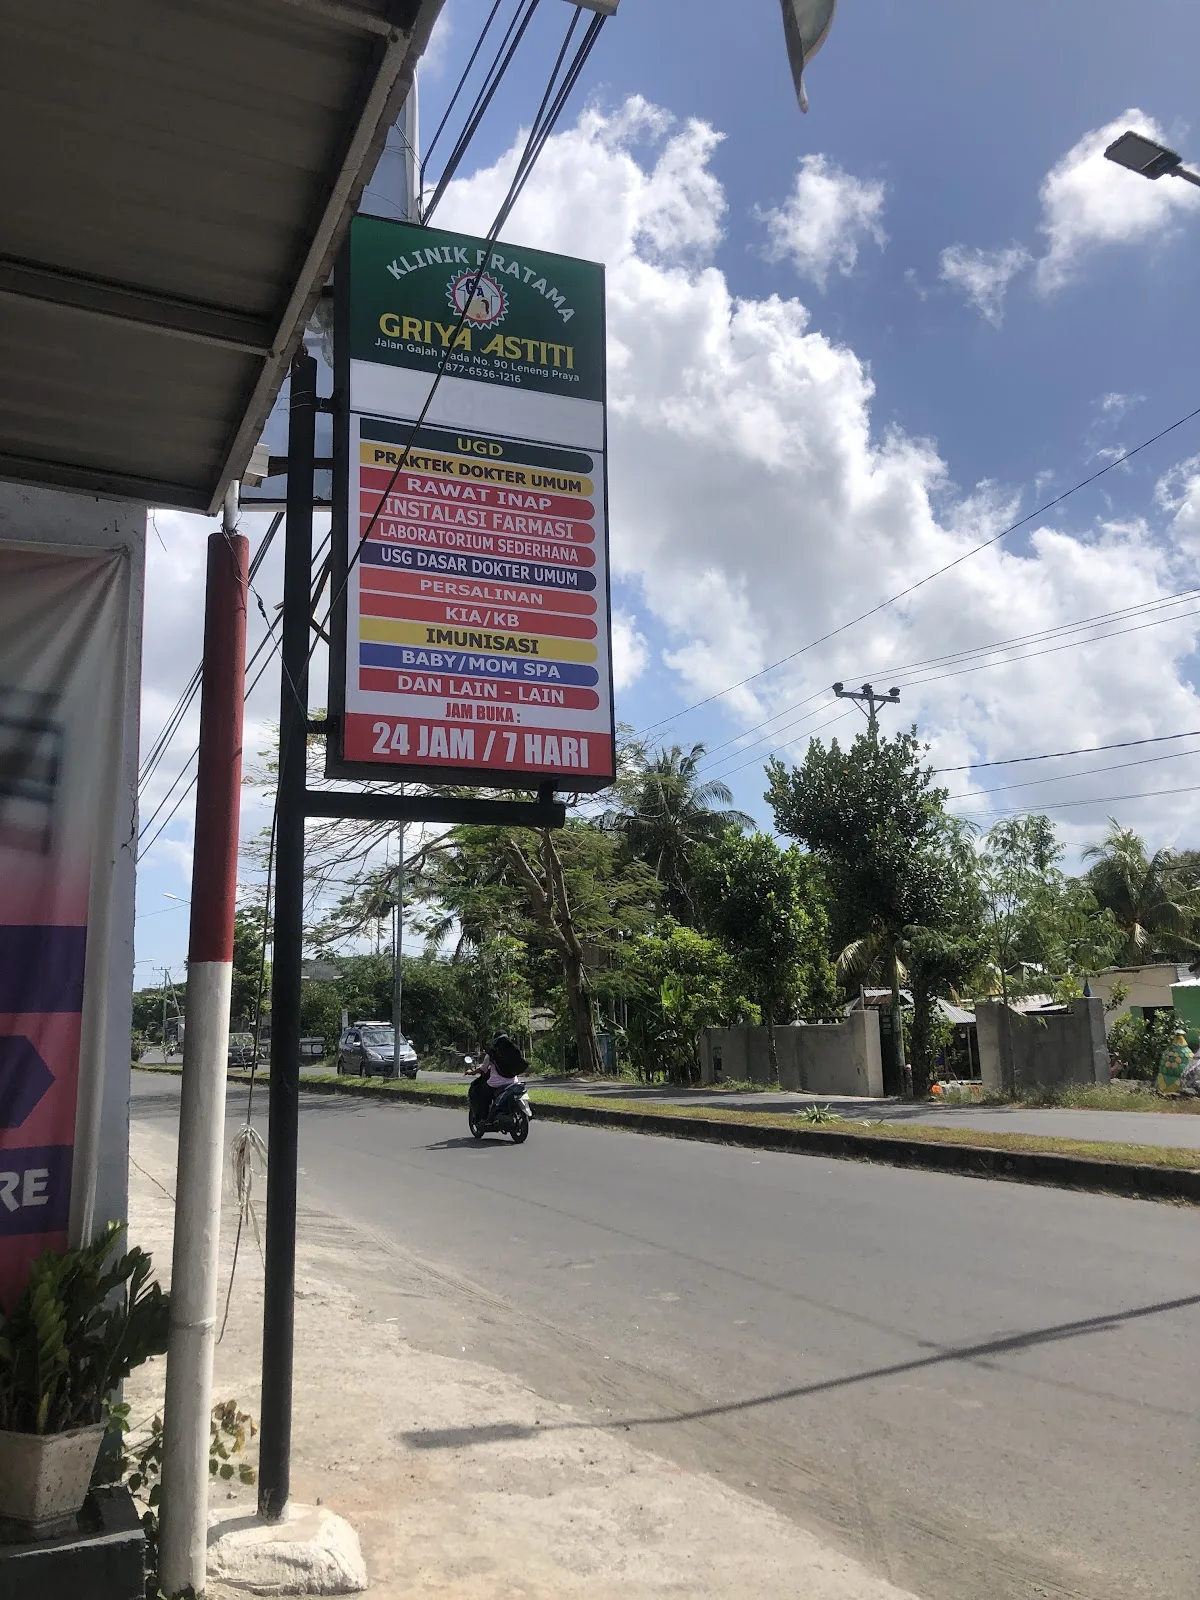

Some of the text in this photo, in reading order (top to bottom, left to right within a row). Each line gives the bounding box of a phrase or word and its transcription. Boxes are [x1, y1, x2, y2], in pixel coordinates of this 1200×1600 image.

[387, 247, 576, 323] KLINIK PRATAMA
[379, 313, 574, 369] GRIYA ASTITI
[375, 338, 403, 351] Jalan
[407, 344, 438, 357] Gajah
[473, 356, 491, 367] No.
[494, 359, 508, 369] 90
[511, 362, 549, 378] Leneng
[552, 369, 580, 382] Praya
[457, 437, 504, 457] UGD
[374, 449, 582, 493] PRAKTEK DOKTER UMUM
[407, 477, 552, 511] RAWAT INAP
[384, 497, 574, 540] INSTALASI FARMASI
[380, 522, 579, 563] LABORATORIUM SEDERHANA
[381, 547, 578, 586] USG DASAR DOKTER UMUM
[420, 579, 543, 606] PERSALINAN
[445, 606, 520, 628] KIA/KB
[426, 628, 539, 655] IMUNISASI
[402, 650, 561, 679] BABY/MOM SPA
[398, 675, 442, 694] DAN
[449, 680, 498, 699] LAIN
[518, 686, 564, 705] LAIN
[445, 702, 473, 720] JAM
[372, 721, 589, 769] 24 JAM / 7 HARI
